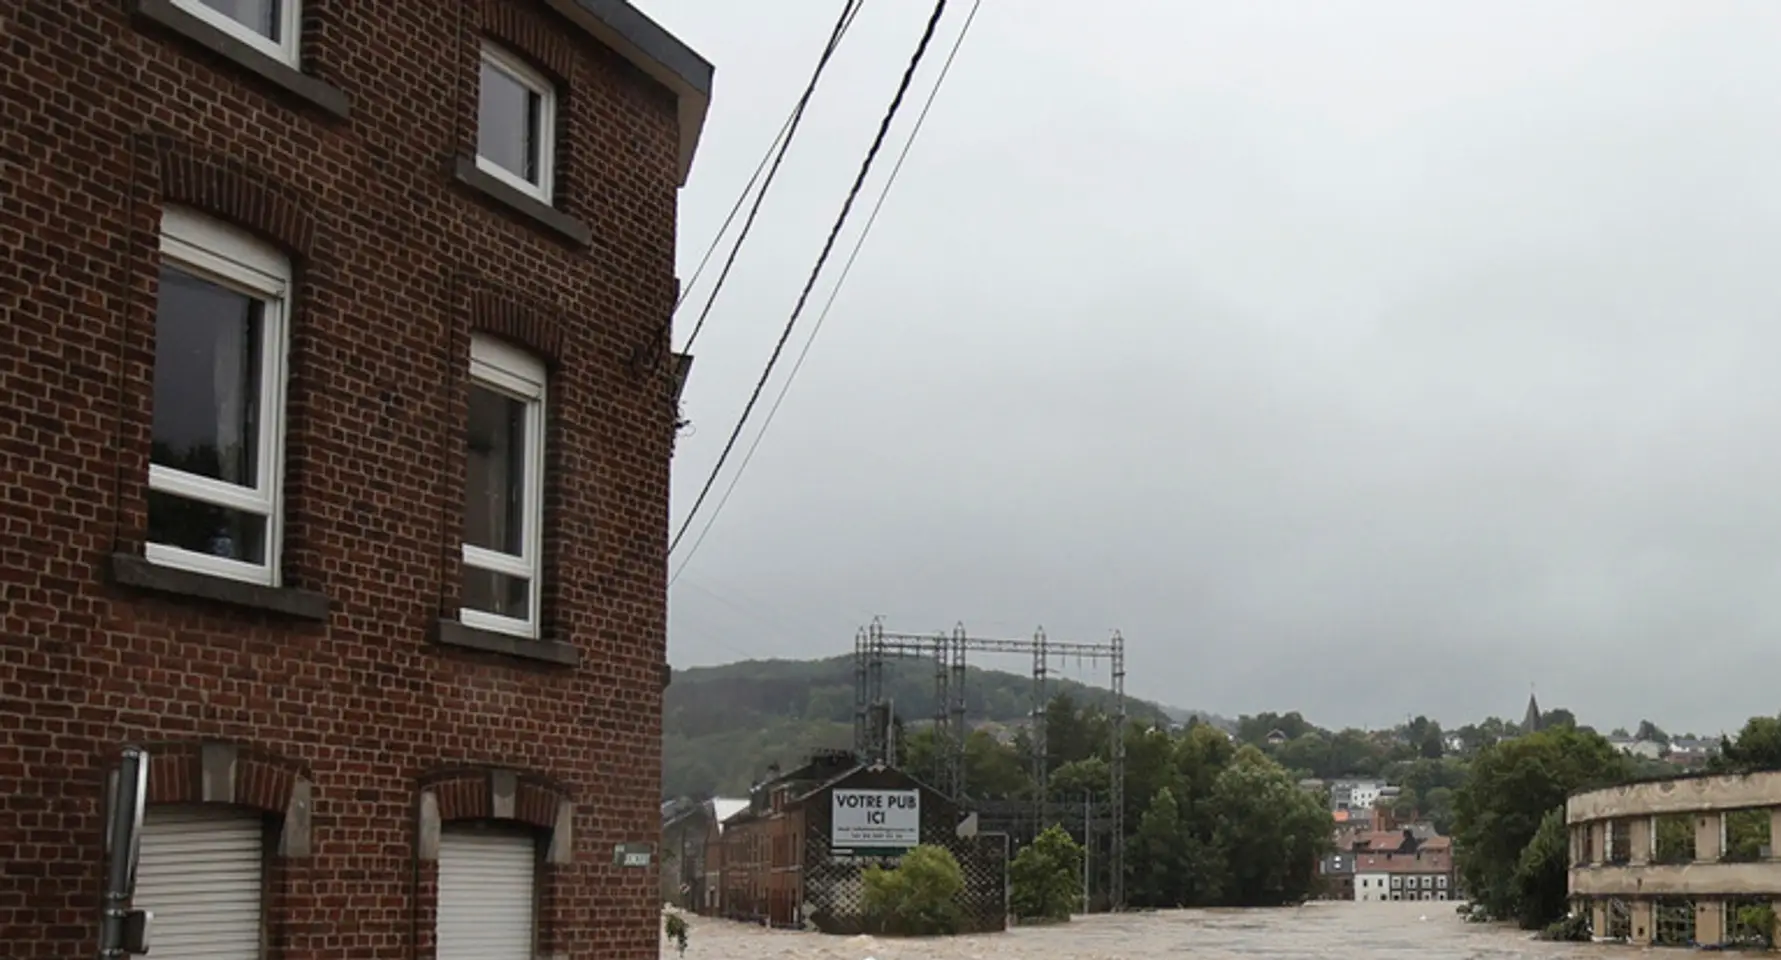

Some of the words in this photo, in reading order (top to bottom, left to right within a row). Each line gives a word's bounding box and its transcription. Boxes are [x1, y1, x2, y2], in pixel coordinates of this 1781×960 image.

[836, 794, 883, 809] VOTRE
[888, 794, 917, 809] PUB
[867, 811, 886, 825] ICI
